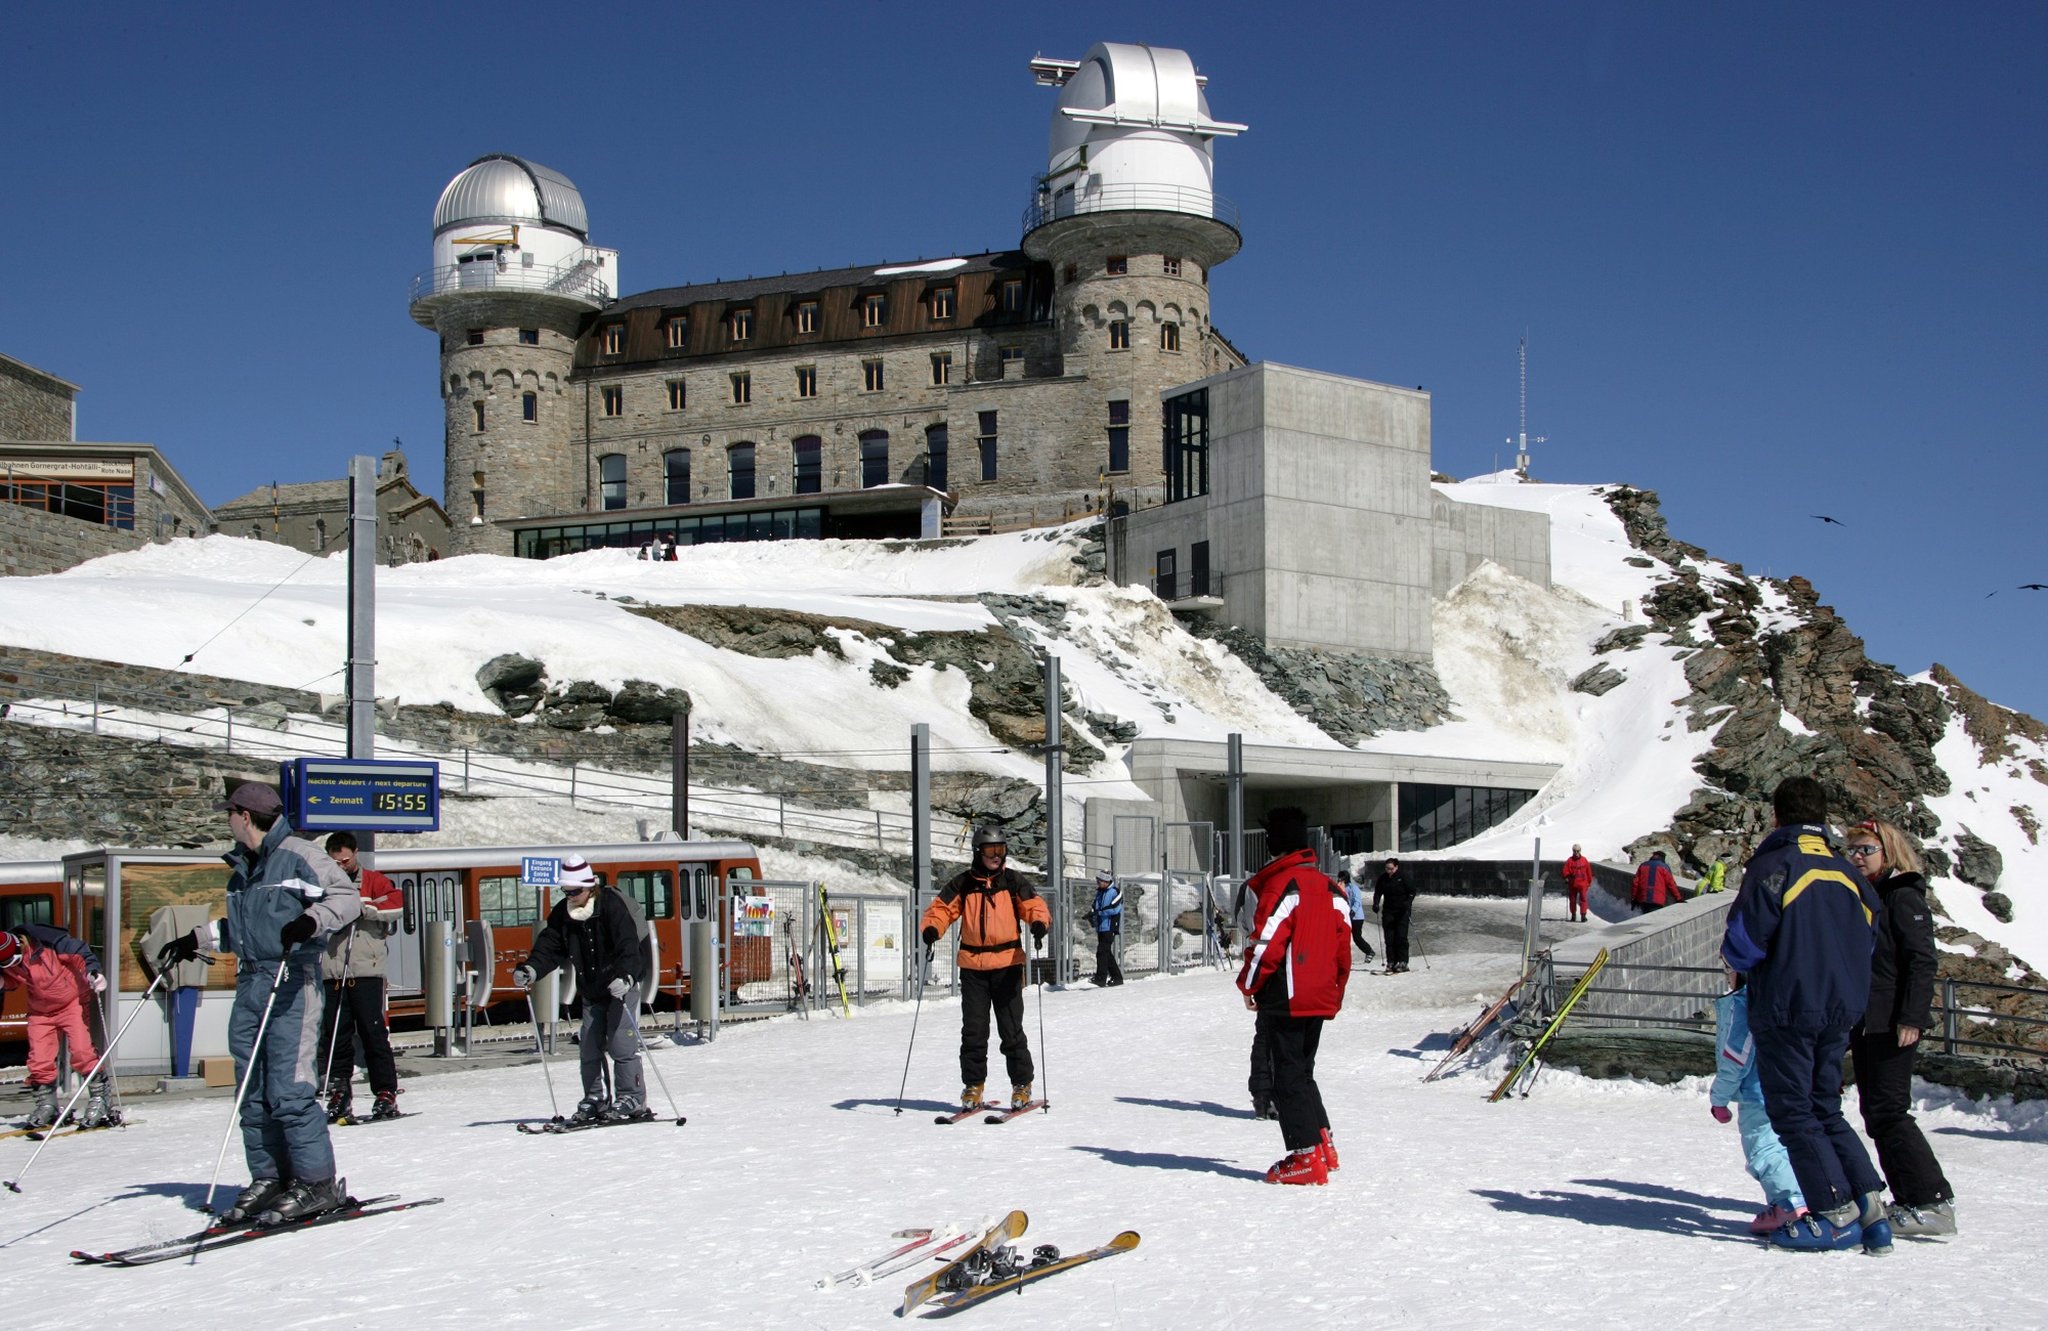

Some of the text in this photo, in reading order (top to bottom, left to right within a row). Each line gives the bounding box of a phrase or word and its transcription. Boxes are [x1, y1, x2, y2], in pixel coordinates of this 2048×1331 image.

[393, 780, 426, 788] departure
[330, 796, 363, 805] Zermatt
[379, 794, 426, 811] 15:55
[1279, 1167, 1312, 1178] SALOMON
